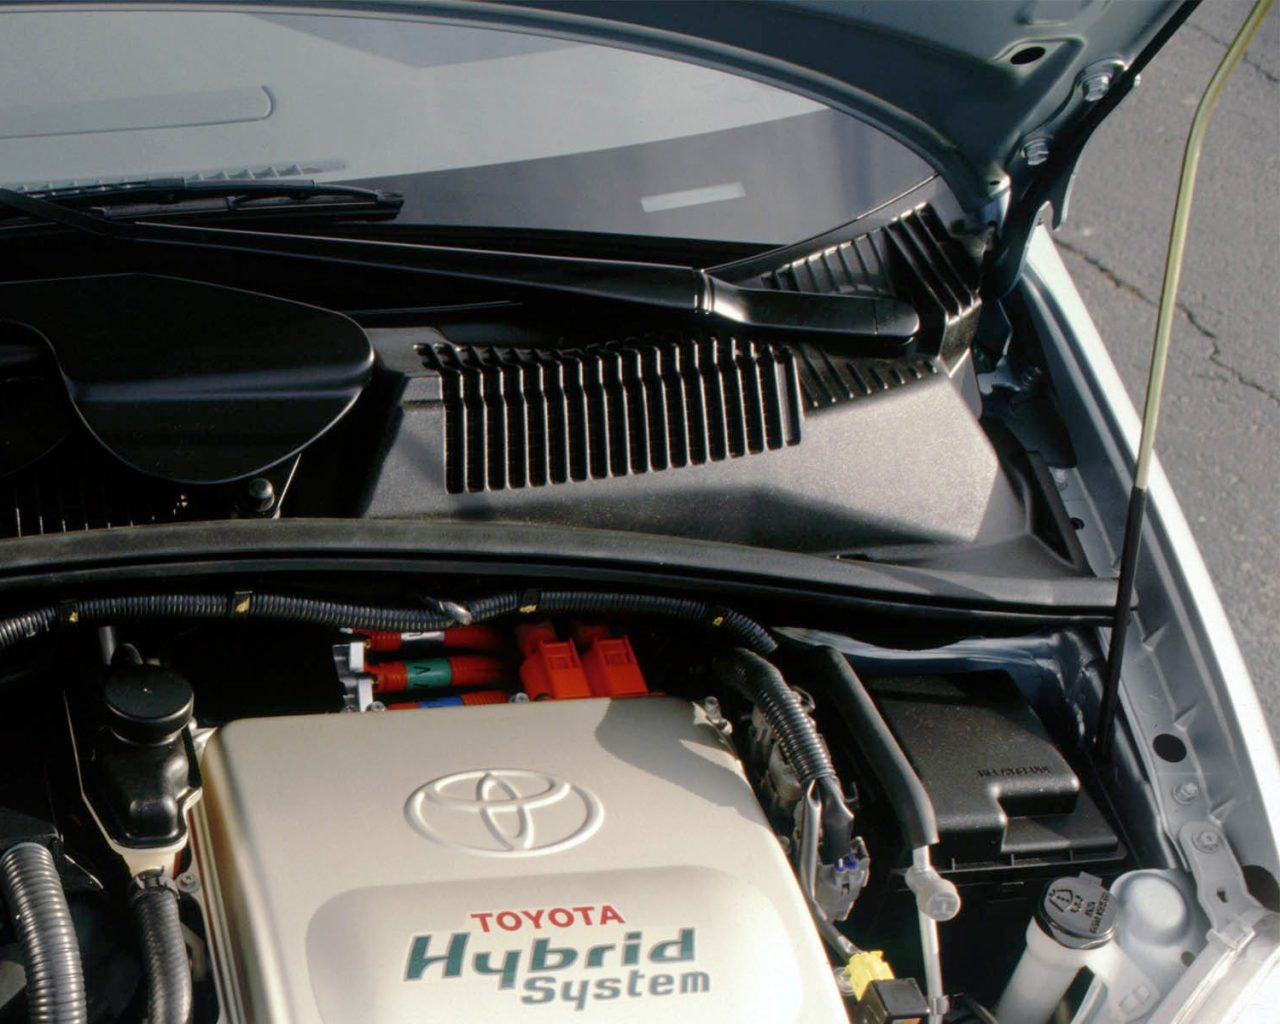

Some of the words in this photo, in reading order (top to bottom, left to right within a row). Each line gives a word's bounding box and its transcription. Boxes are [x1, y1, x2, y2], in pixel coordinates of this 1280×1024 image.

[471, 904, 625, 933] TOYOTA
[404, 927, 696, 990] Hybrid
[521, 970, 710, 1011] System
